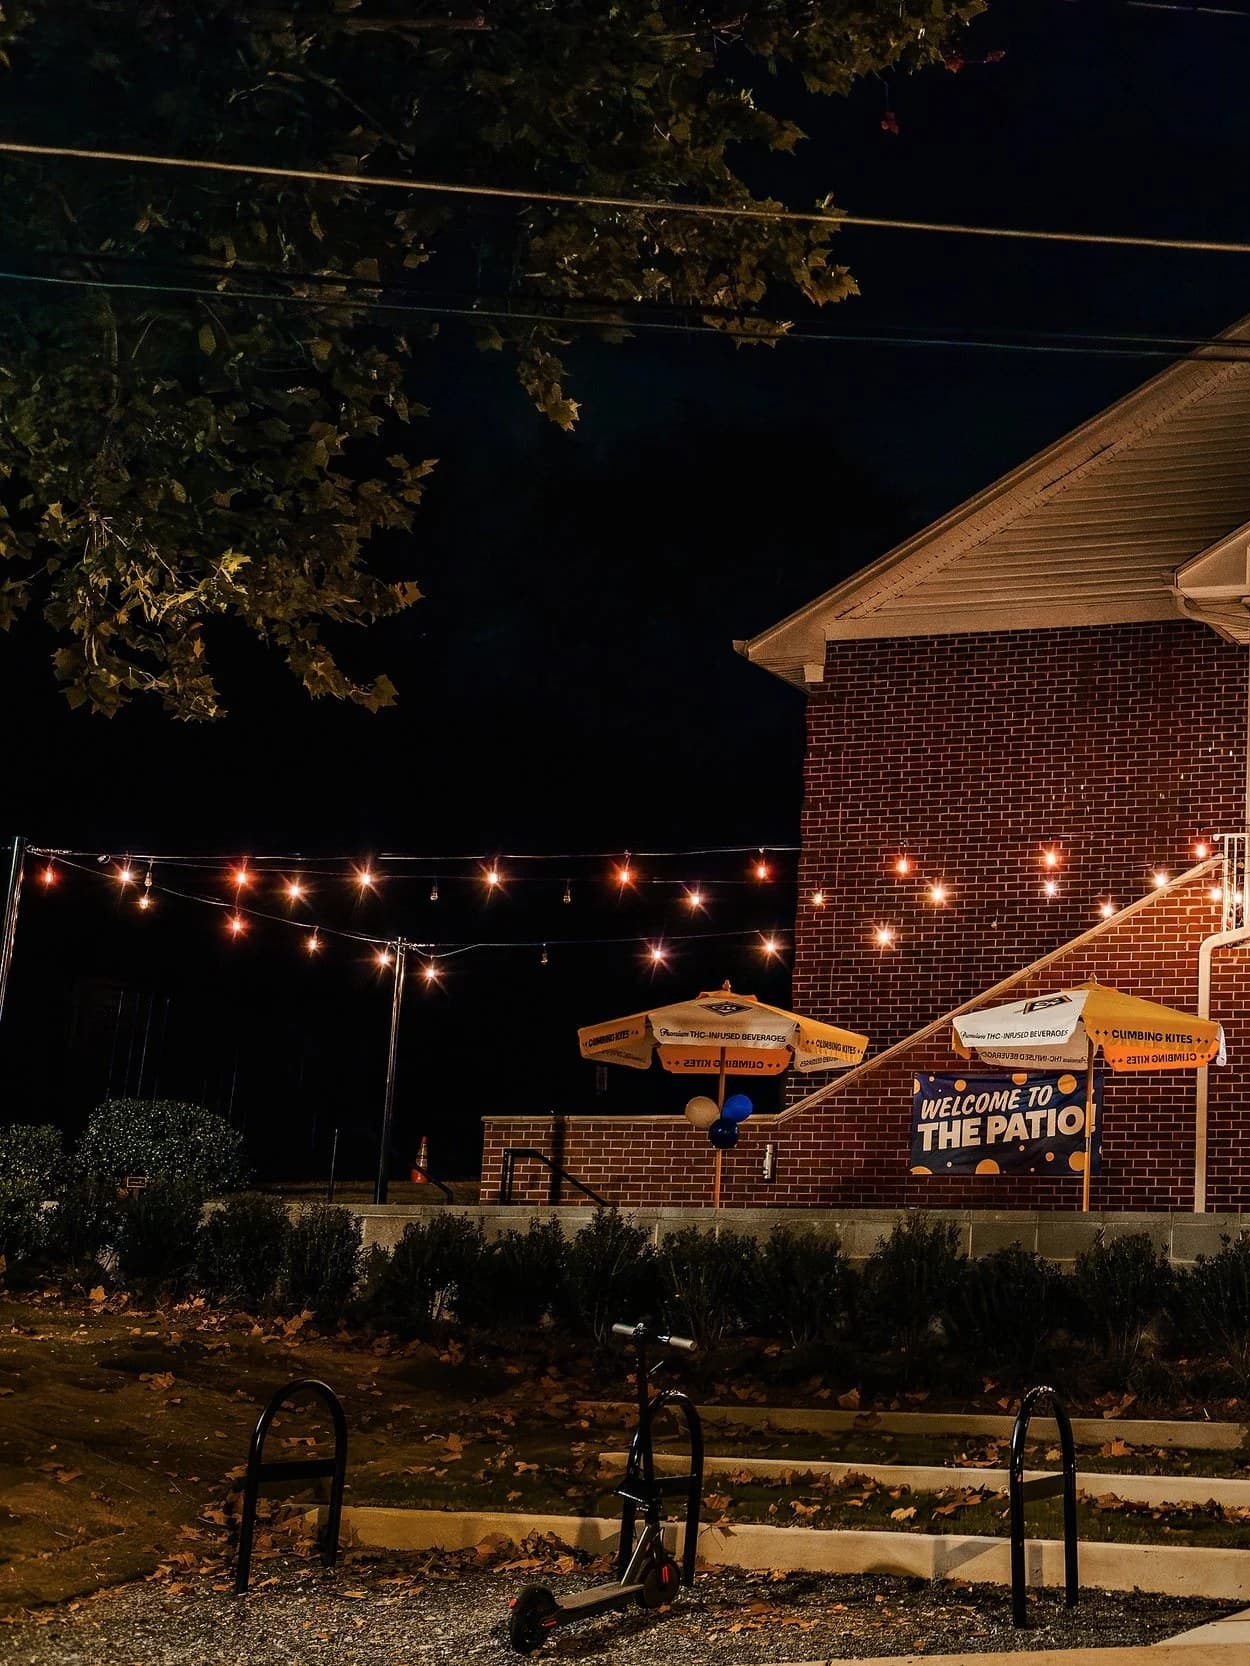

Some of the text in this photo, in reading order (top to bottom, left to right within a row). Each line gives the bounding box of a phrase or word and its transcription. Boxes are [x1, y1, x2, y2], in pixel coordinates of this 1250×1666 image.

[690, 1030, 740, 1040] THC-INFUSED
[741, 1033, 786, 1042] BEVERAGES
[987, 1031, 1028, 1040] THC-INFUSED
[1030, 1029, 1069, 1038] BEVERAGES
[1111, 1029, 1193, 1044] CLIMBING KITES
[921, 1085, 1053, 1120] WELCOME TO
[917, 1117, 982, 1151] THE
